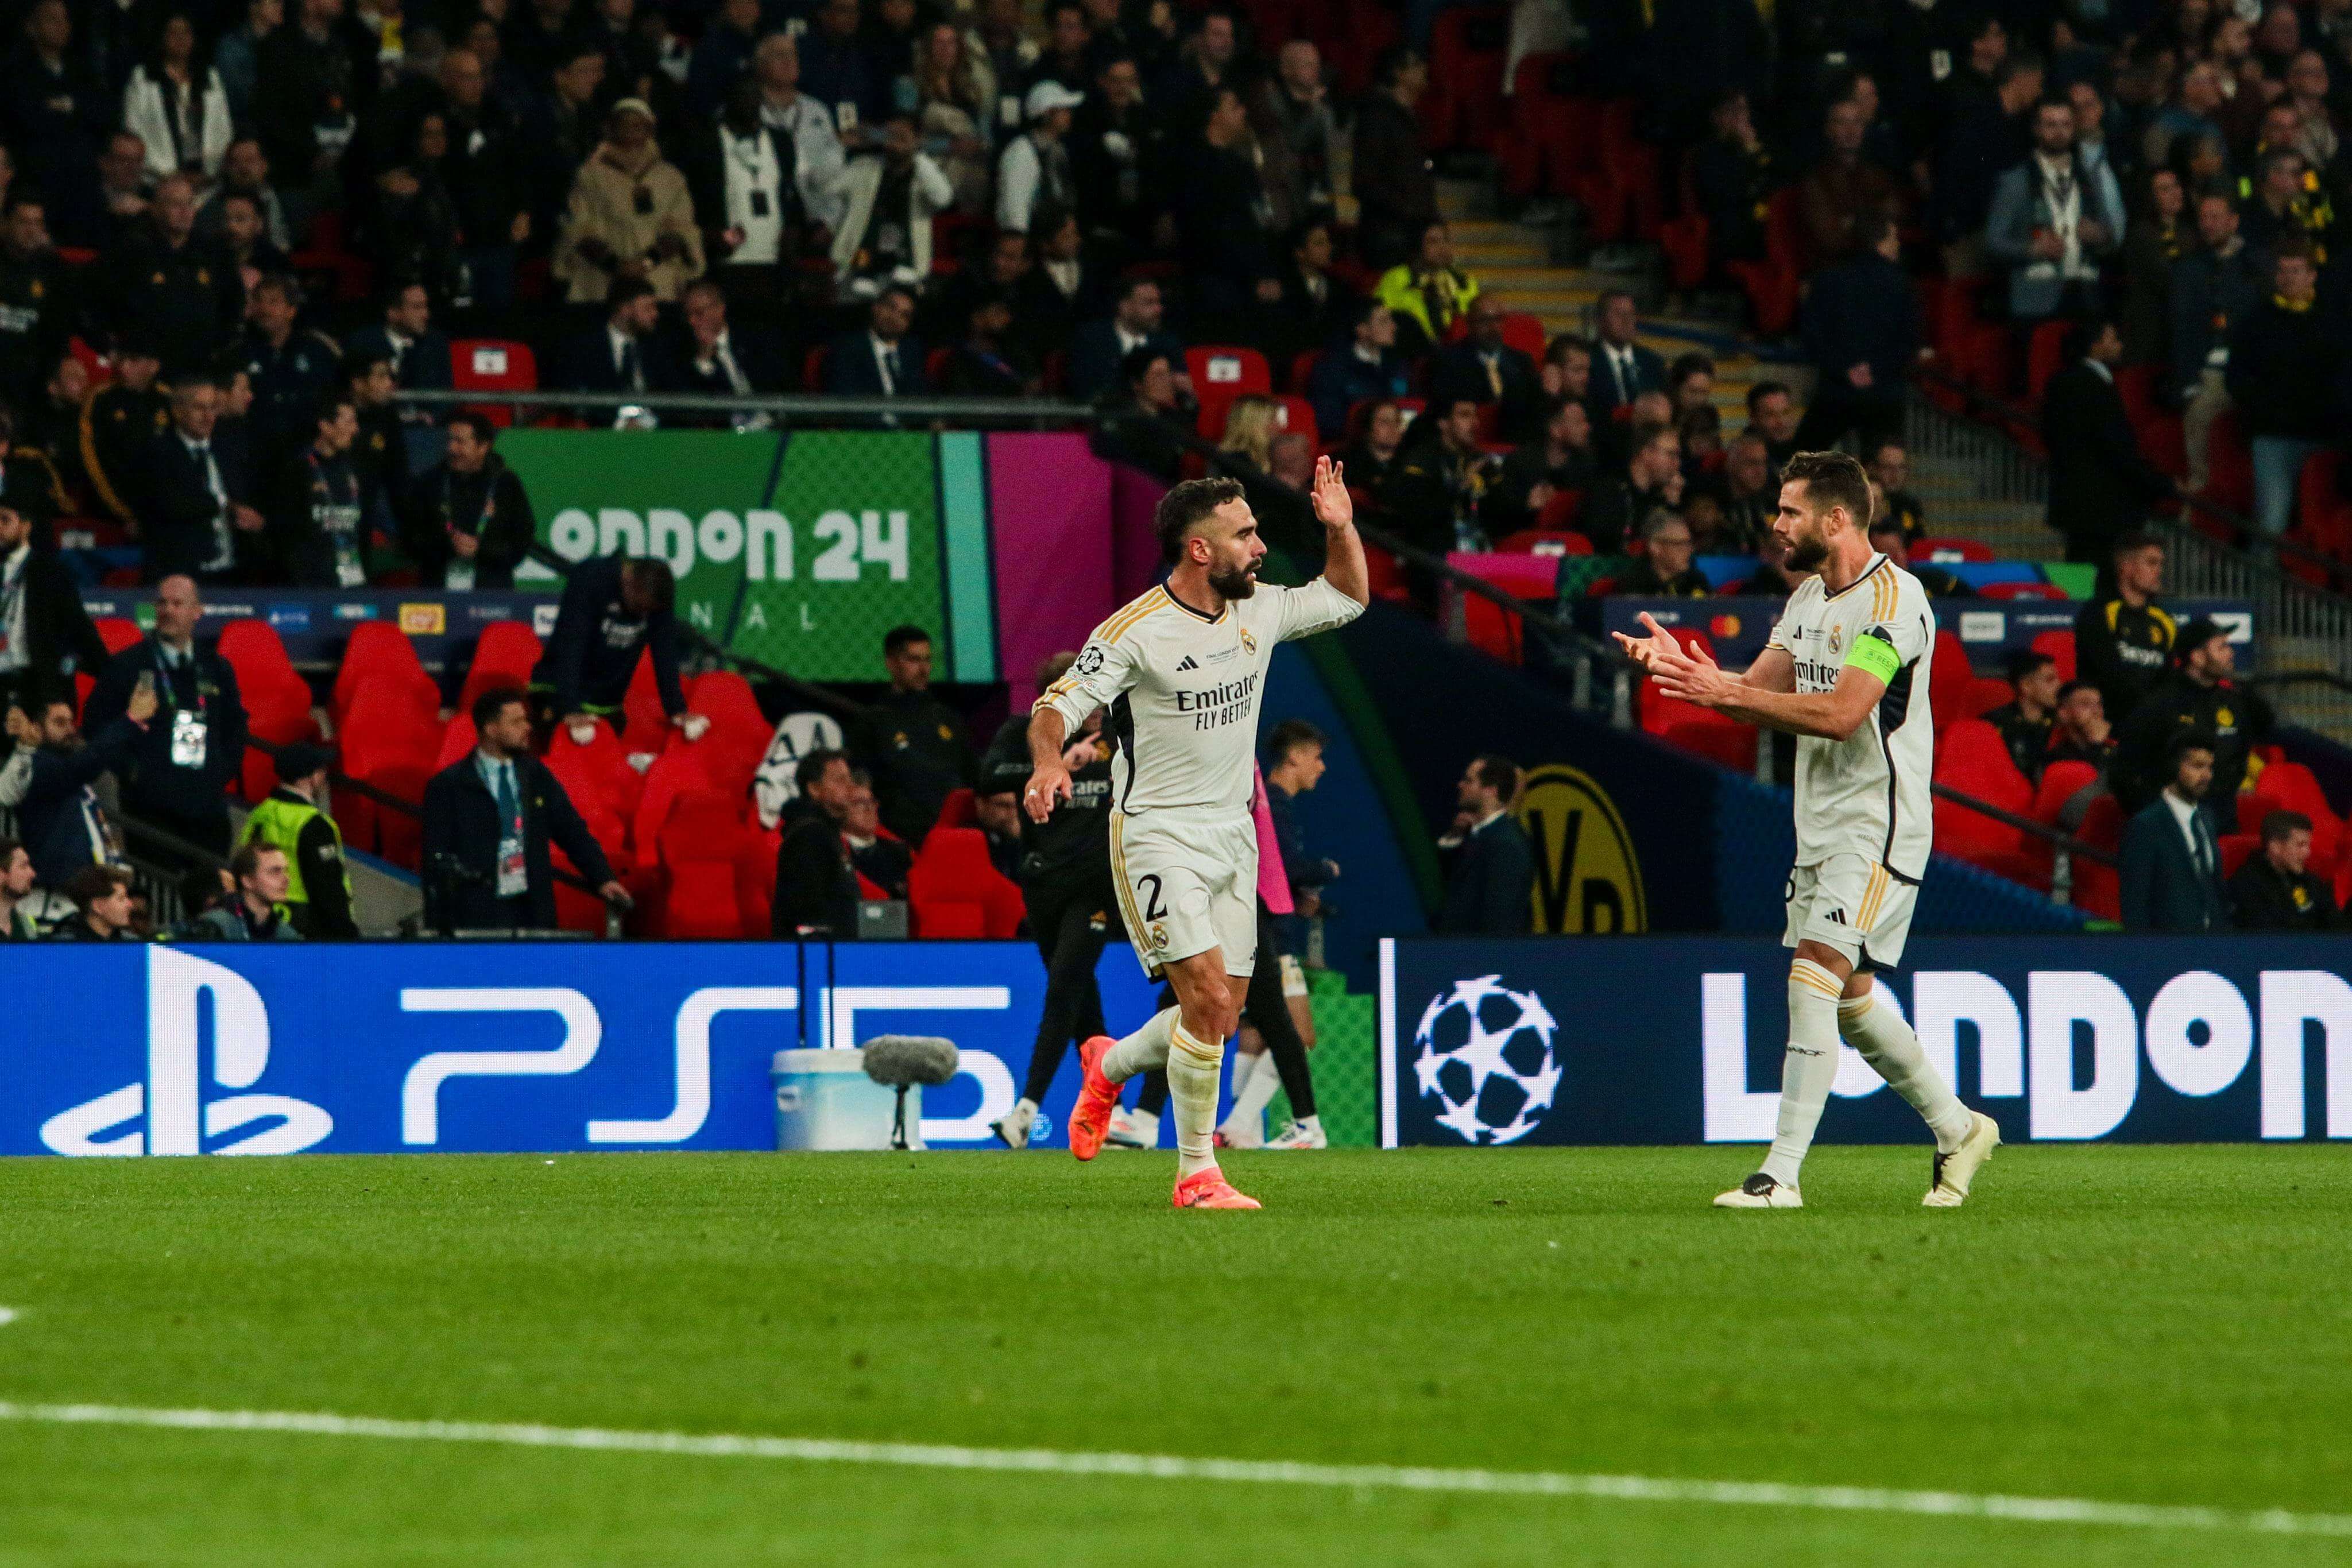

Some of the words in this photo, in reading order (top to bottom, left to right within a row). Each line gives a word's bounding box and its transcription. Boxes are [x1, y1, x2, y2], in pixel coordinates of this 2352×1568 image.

[813, 509, 908, 582] 24
[690, 602, 818, 631] NAL
[1177, 671, 1259, 711] Emirates
[1196, 707, 1219, 731] FLY
[1221, 696, 1252, 726] BETTER
[1138, 874, 1168, 922] 2
[401, 986, 1015, 1144] PS5
[1701, 970, 2352, 1141] LNDON
